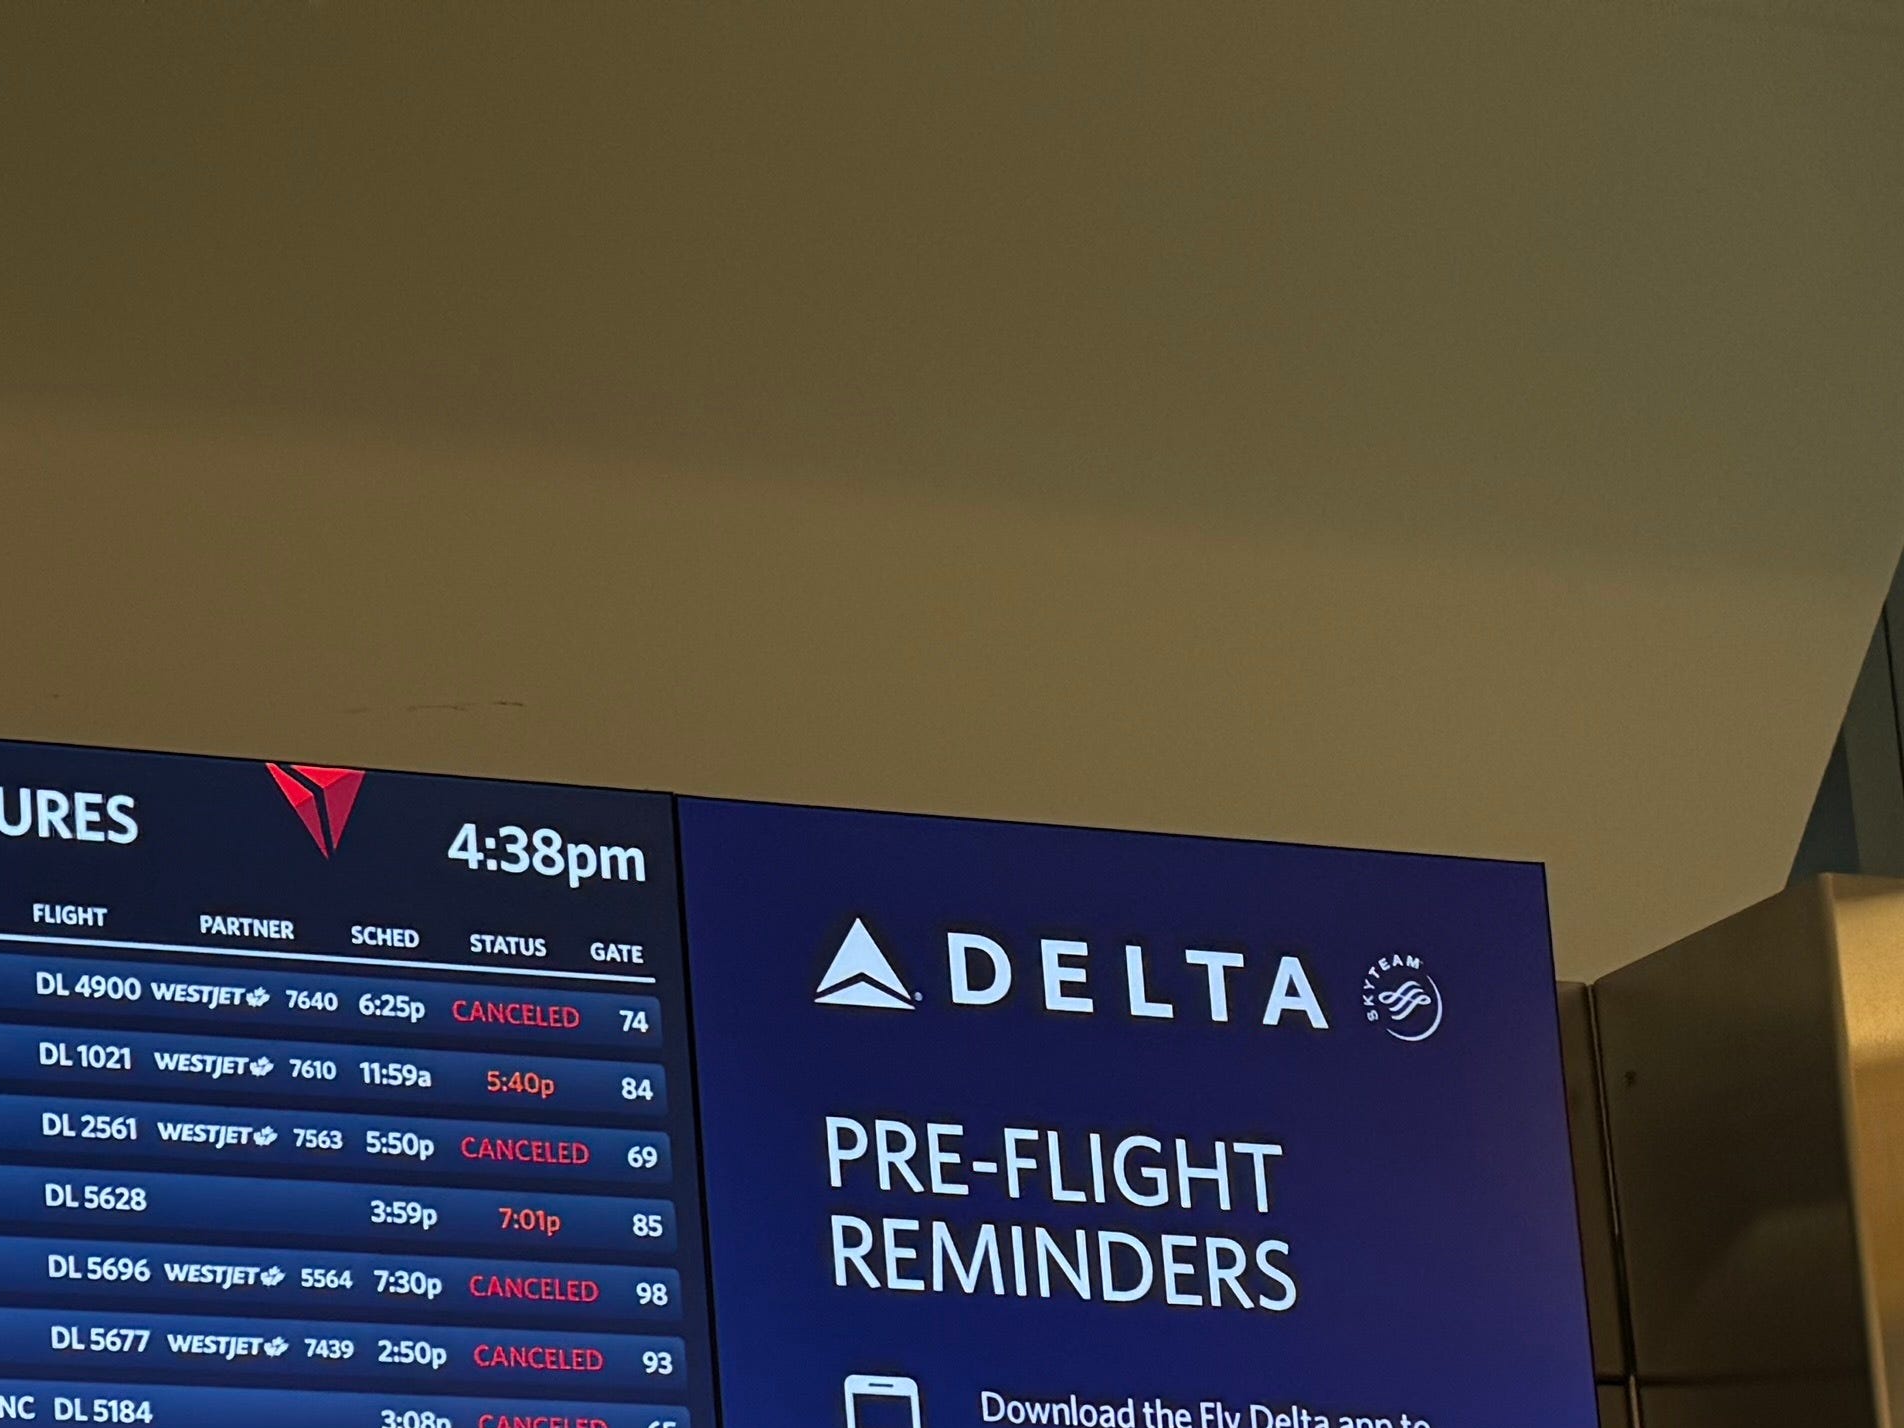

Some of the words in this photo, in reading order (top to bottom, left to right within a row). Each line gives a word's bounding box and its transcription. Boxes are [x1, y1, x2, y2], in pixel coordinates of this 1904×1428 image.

[948, 932, 1328, 1028] DELTA
[1362, 954, 1421, 1022] SKYTEAM
[826, 1117, 1282, 1212] PRE-FLIGHT
[831, 1215, 1296, 1310] REMINDERS
[981, 1391, 1135, 1428] Download
